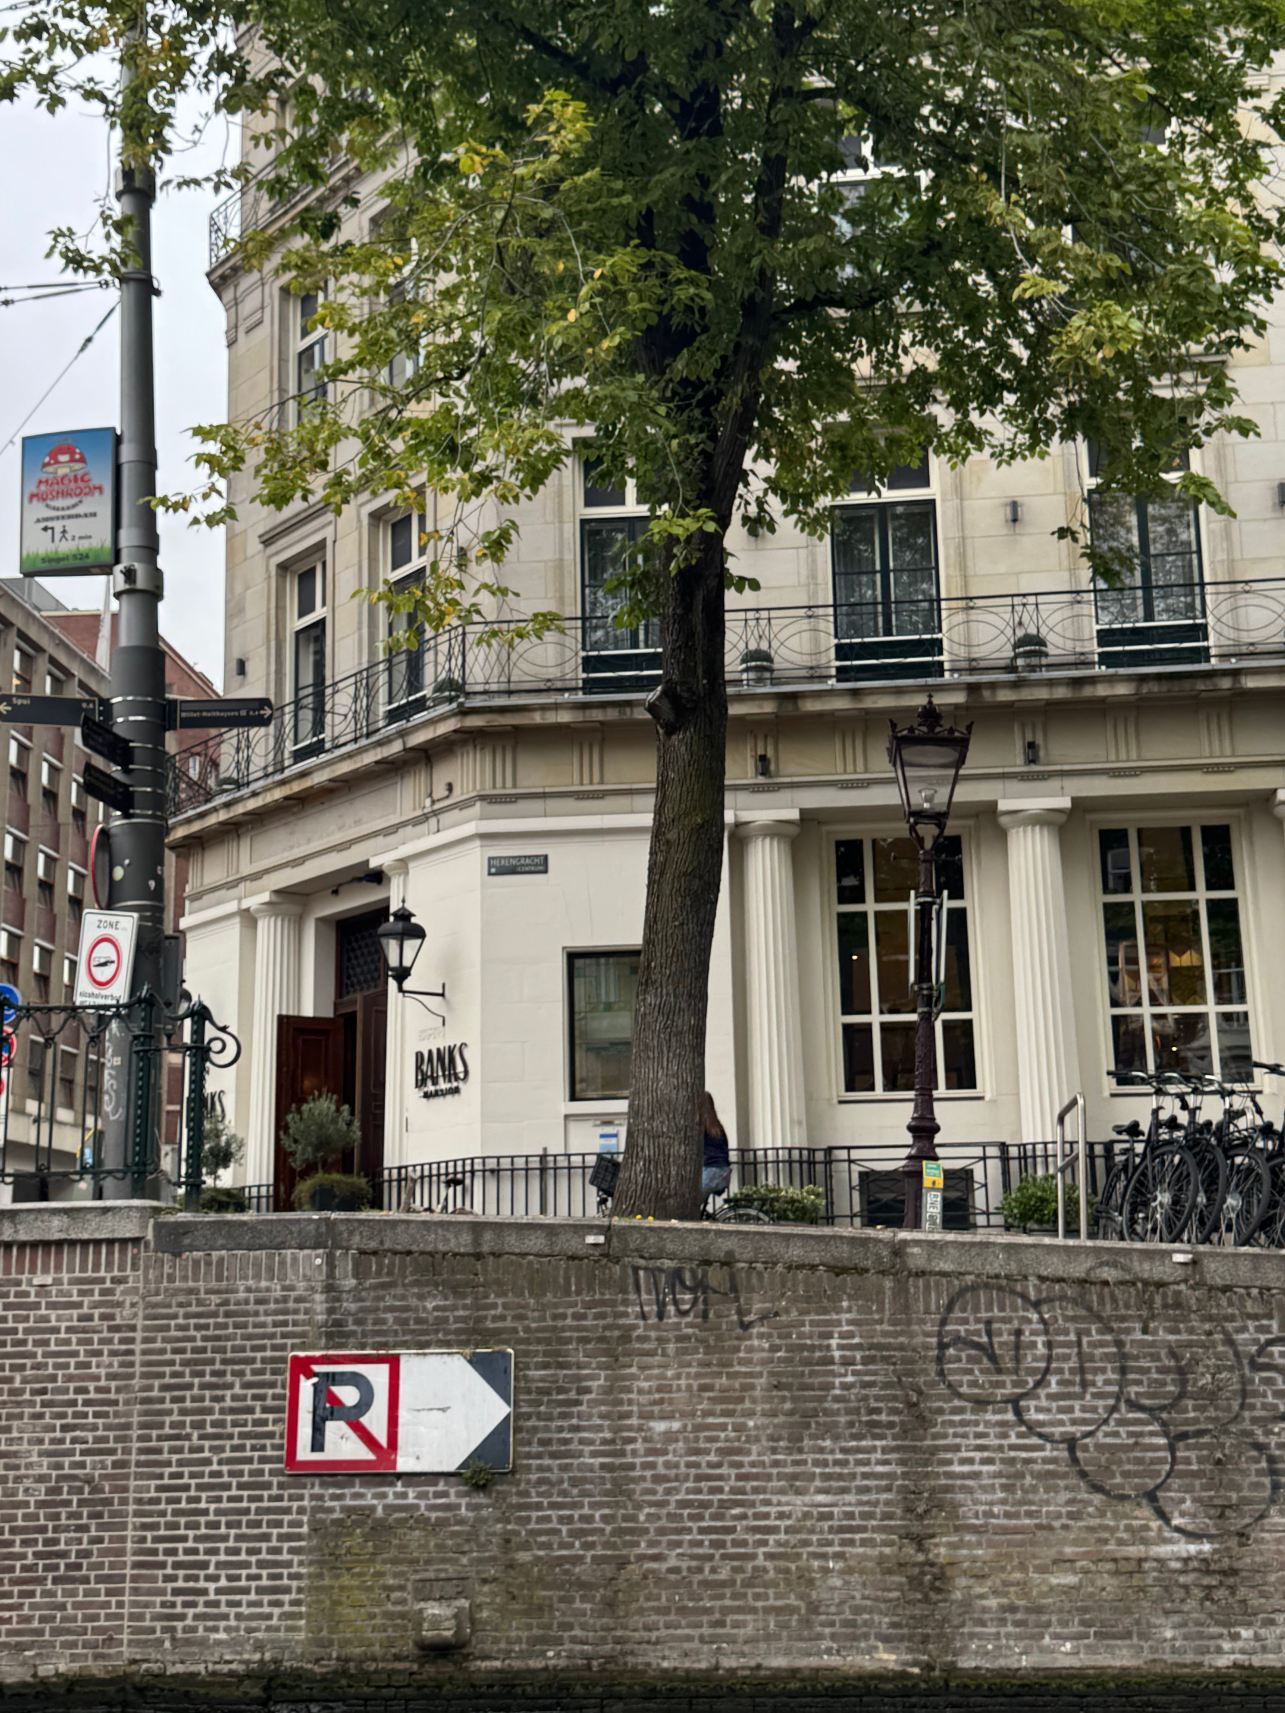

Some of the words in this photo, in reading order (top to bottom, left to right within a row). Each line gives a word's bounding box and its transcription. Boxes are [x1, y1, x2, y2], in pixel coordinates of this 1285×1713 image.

[36, 472, 92, 490] MAGIC
[28, 484, 105, 504] MUSHROOM
[12, 697, 31, 706] Spui
[490, 857, 545, 867] HERENGRACHT
[97, 920, 120, 930] ZONE
[414, 1042, 469, 1089] BANKS
[310, 1371, 375, 1453] P
